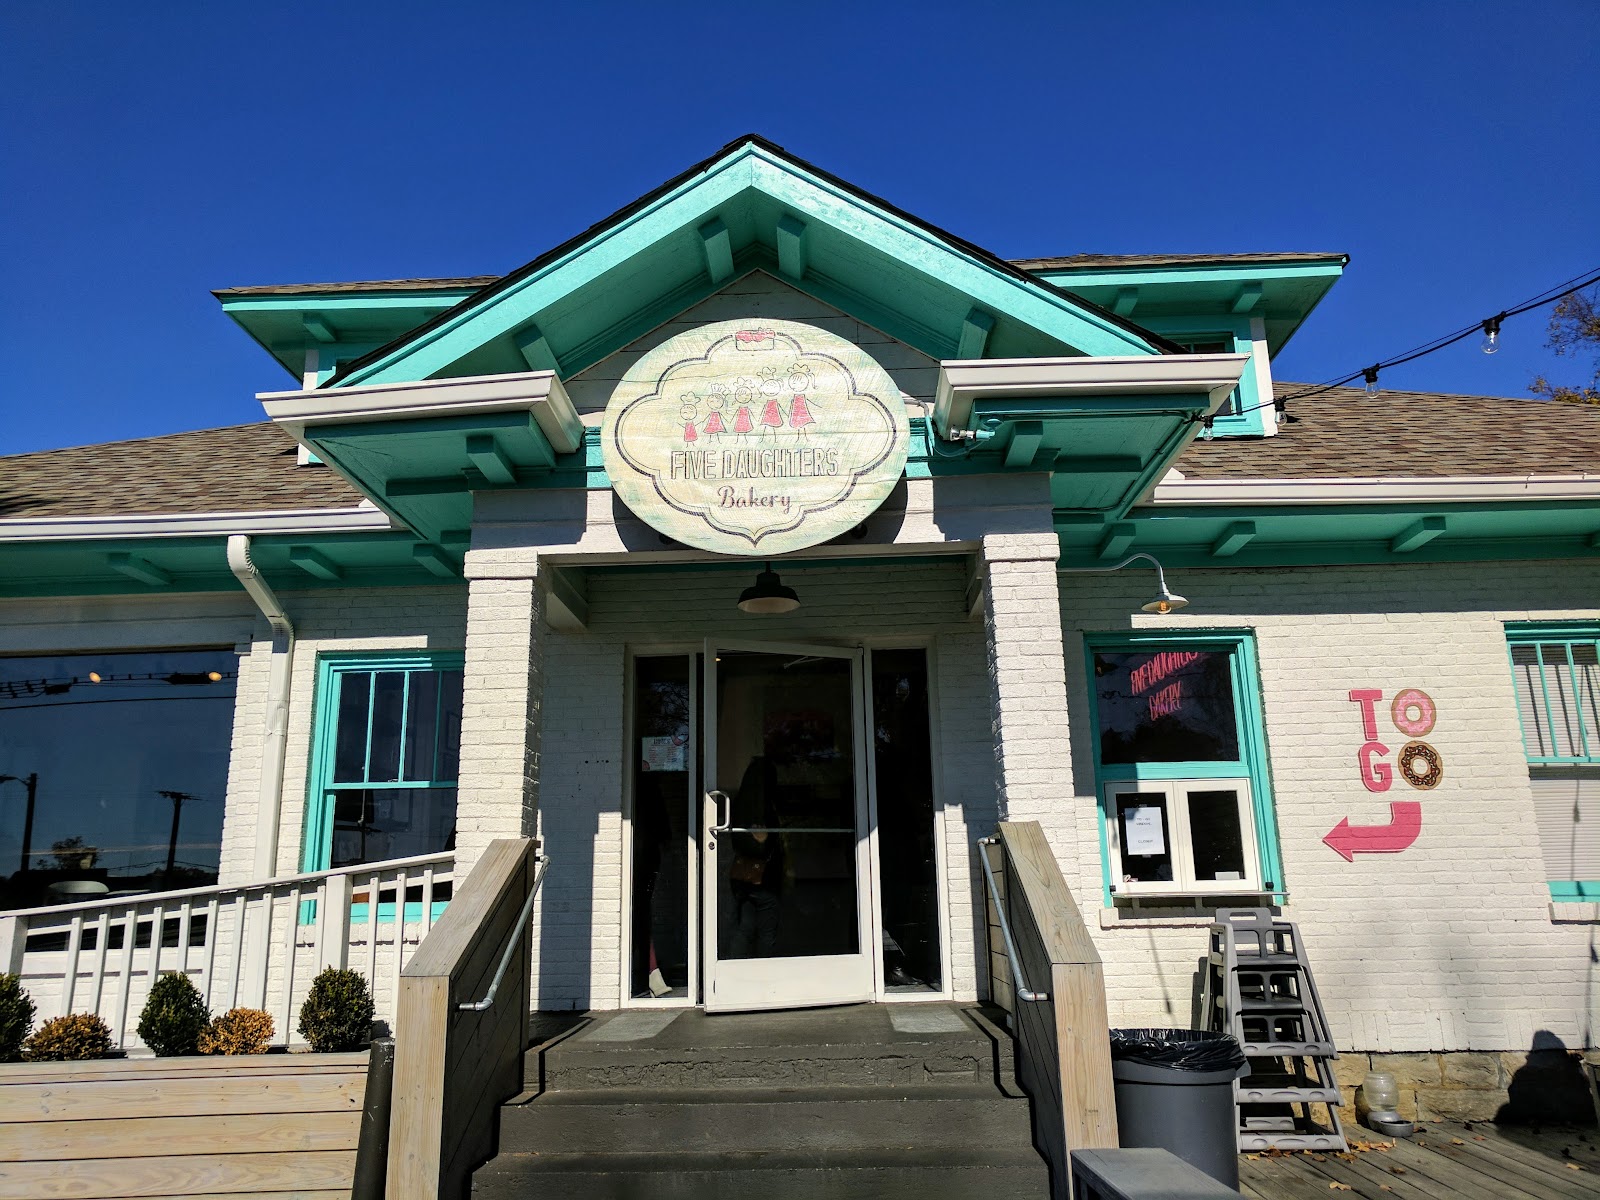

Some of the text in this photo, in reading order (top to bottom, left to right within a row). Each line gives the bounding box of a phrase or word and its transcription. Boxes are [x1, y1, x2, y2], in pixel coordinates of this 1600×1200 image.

[671, 447, 839, 479] FIVE DAUGHTERS
[717, 486, 792, 514] Bakery
[1147, 652, 1198, 686] DAUGHTE
[1349, 689, 1437, 741] TO
[1358, 740, 1443, 793] GO
